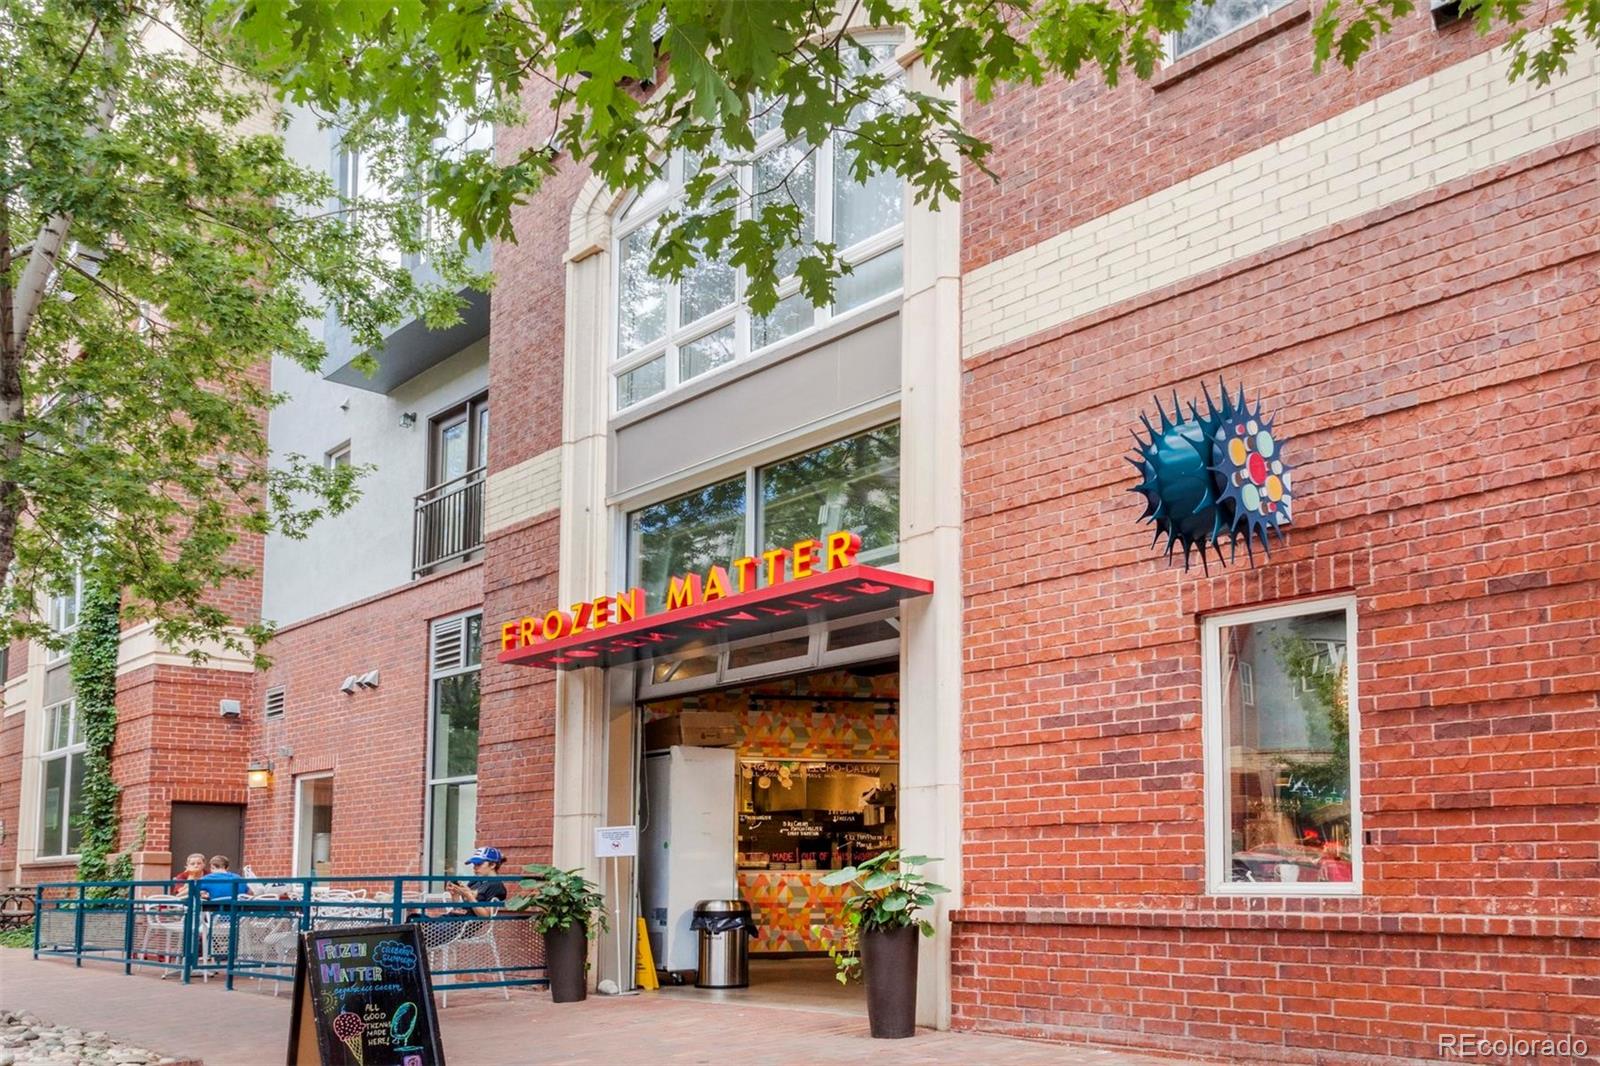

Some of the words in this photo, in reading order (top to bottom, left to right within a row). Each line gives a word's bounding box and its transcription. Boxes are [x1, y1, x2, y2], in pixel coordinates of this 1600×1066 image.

[501, 587, 641, 652] FROZEN
[666, 530, 857, 611] MATTER
[316, 939, 368, 961] FROZEN
[320, 963, 383, 984] MATTER
[365, 1003, 380, 1012] ALL
[363, 1012, 387, 1021] GOOD
[366, 1029, 387, 1037] MADE
[368, 1036, 391, 1047] HERE!
